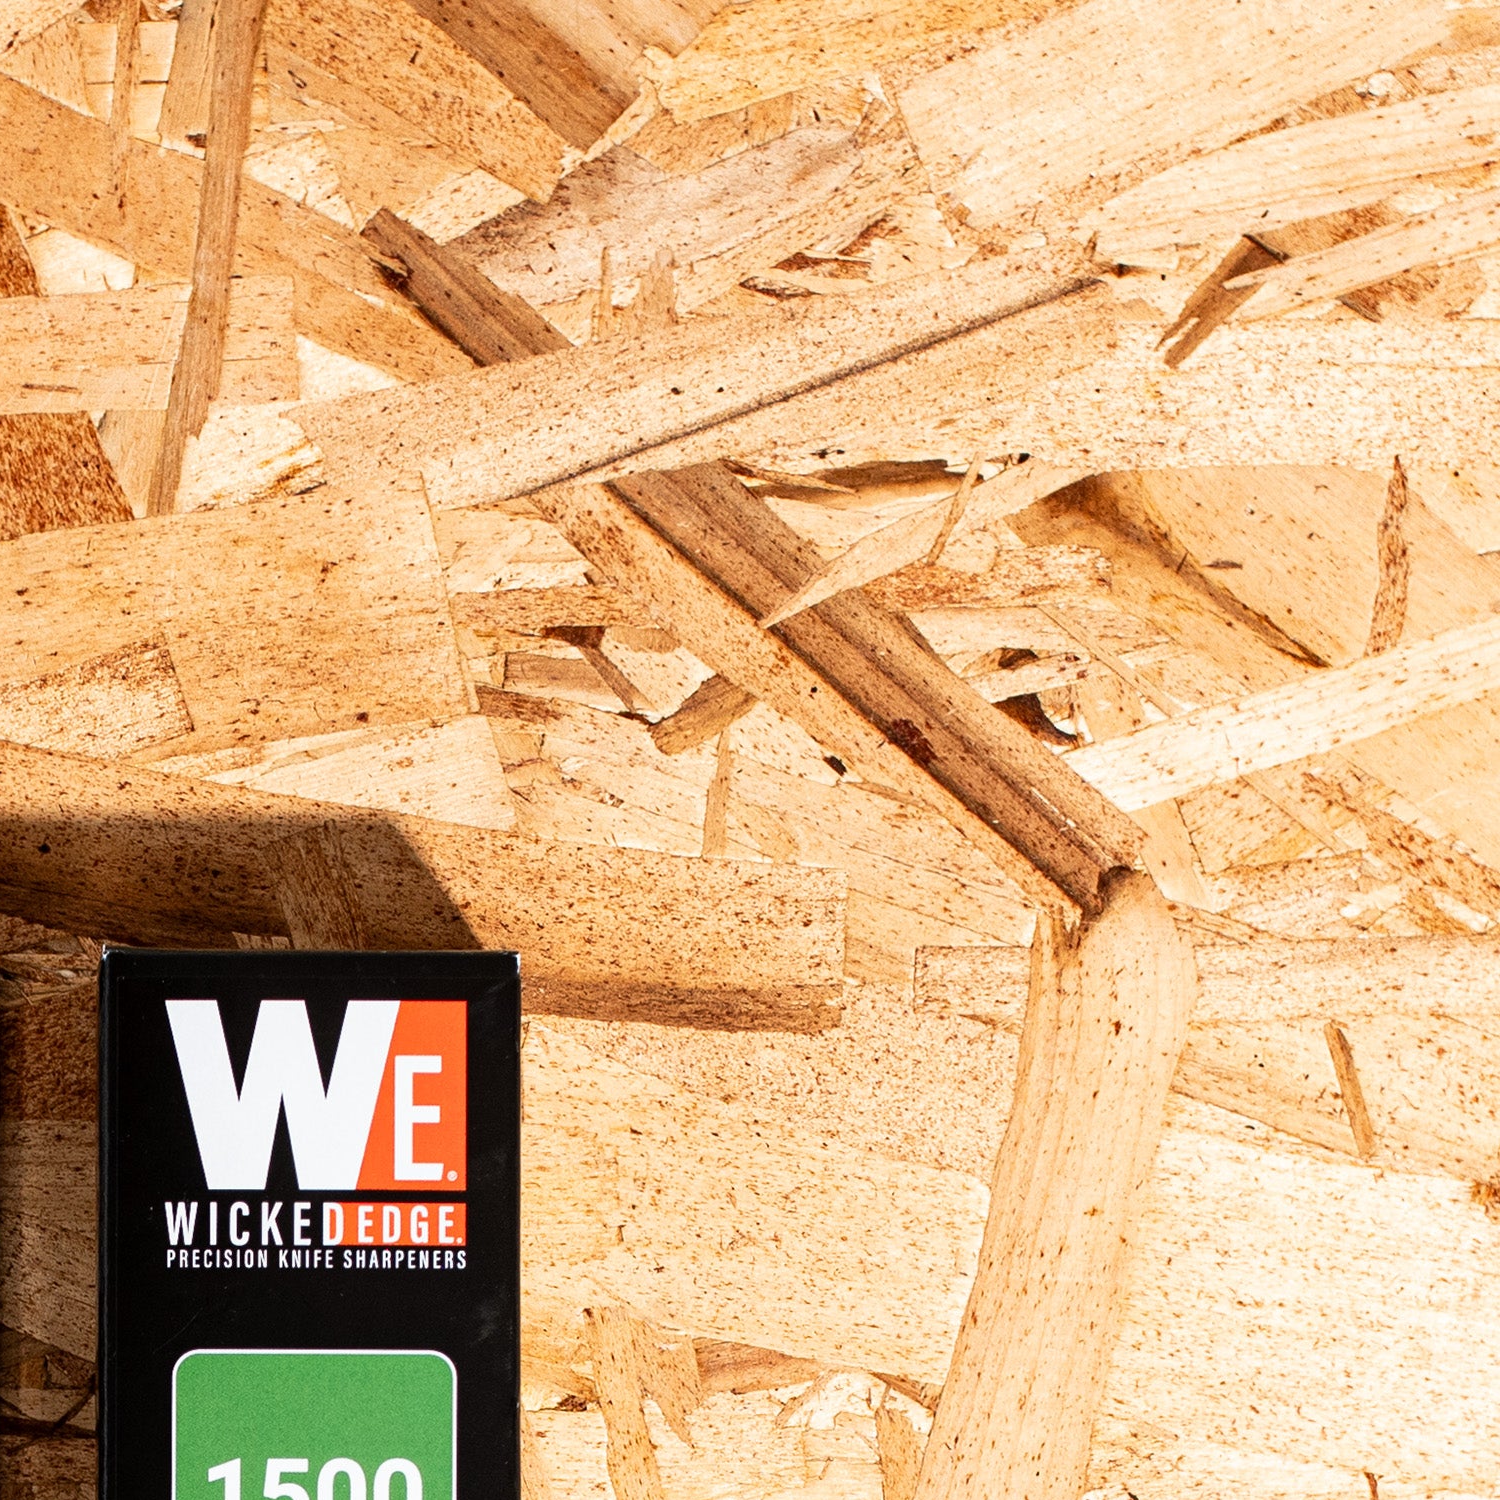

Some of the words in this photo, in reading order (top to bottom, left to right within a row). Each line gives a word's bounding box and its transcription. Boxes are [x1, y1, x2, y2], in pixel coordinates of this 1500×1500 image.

[166, 1248, 268, 1269] PRECISION
[278, 1249, 334, 1269] KNIFE
[343, 1249, 467, 1270] SHARPENERS
